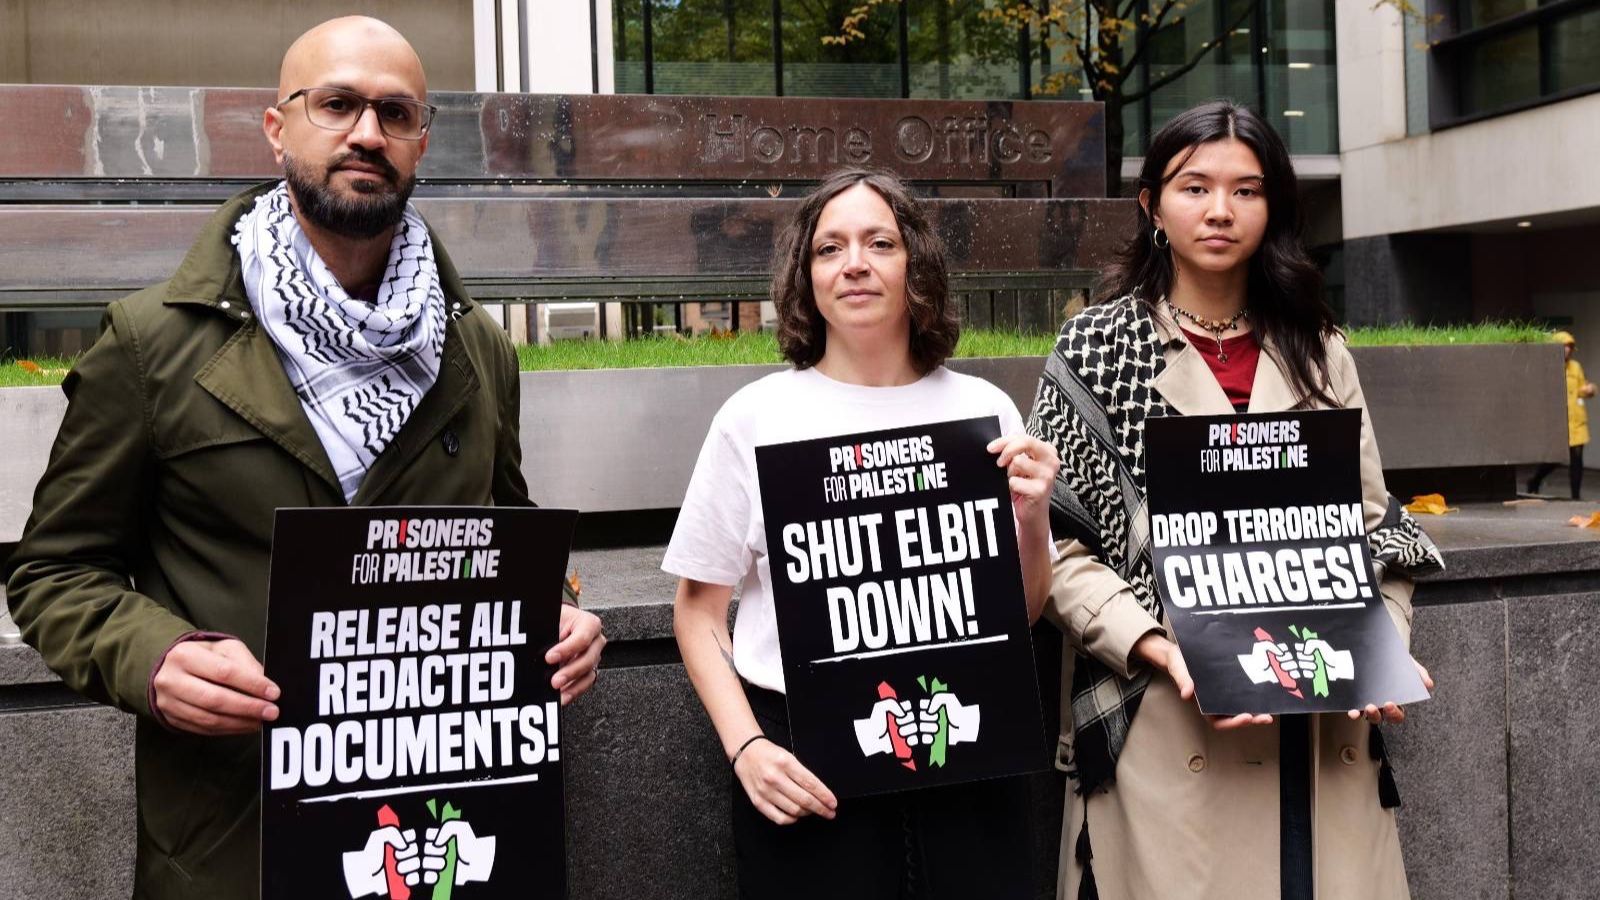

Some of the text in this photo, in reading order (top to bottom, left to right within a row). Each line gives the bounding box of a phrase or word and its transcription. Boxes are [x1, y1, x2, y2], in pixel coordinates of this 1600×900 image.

[700, 113, 1052, 164] Home Office
[829, 435, 935, 473] PRISONERS
[1209, 420, 1300, 446] PRISONERS
[1201, 449, 1221, 473] FOR
[823, 475, 848, 503] FOR
[366, 518, 494, 549] PRISONERS
[782, 498, 999, 584] SHUT ELBIT
[1151, 503, 1365, 547] DROP TERRORISM
[351, 553, 380, 584] FOR
[1163, 543, 1373, 608] CHARGES!
[310, 600, 526, 658] RELEASE ALL
[826, 567, 979, 653] DOWN!
[319, 651, 515, 716] REDACTED
[270, 702, 559, 790] DOCUMENTS!
